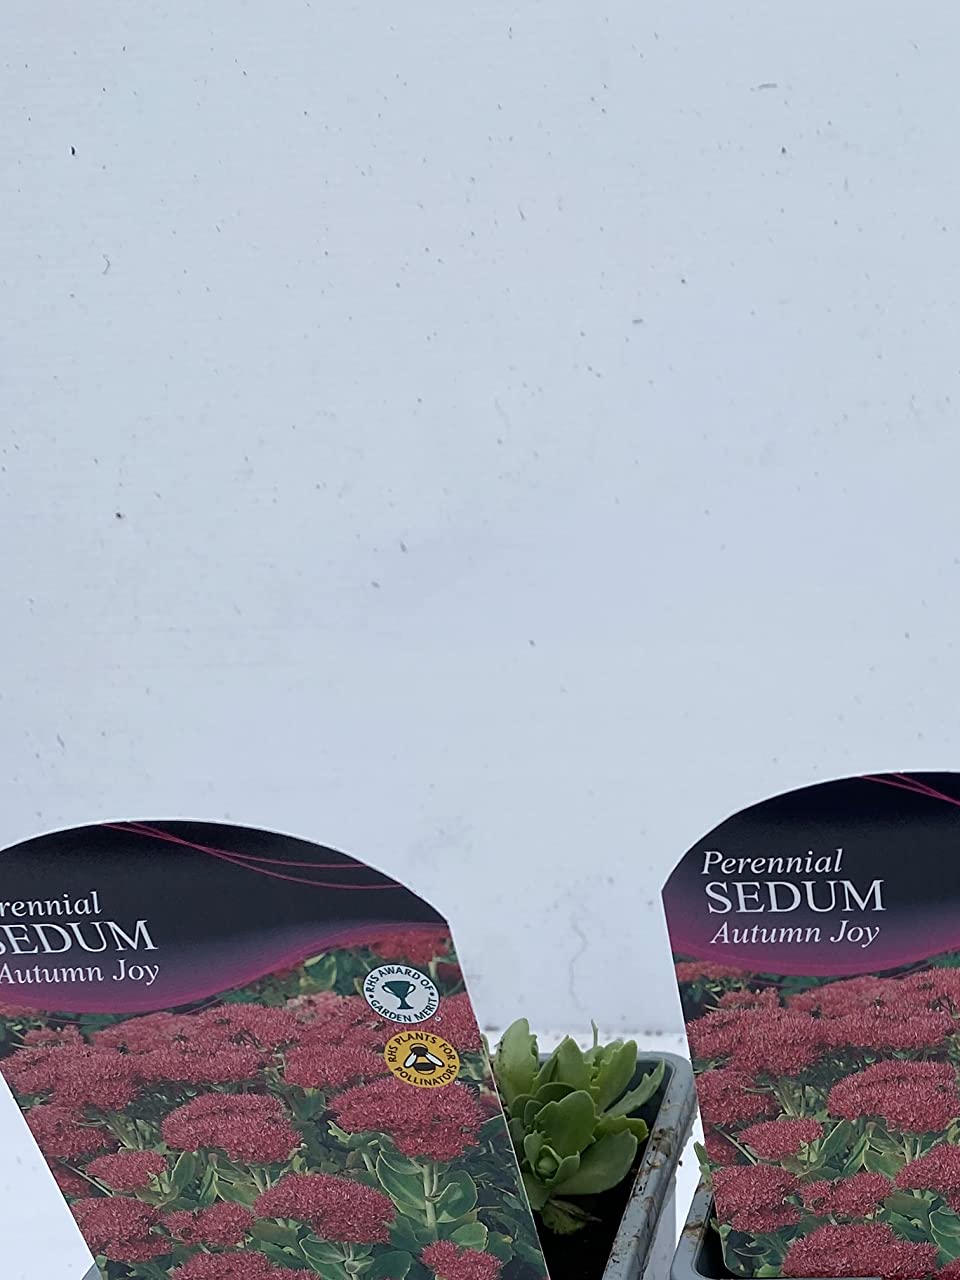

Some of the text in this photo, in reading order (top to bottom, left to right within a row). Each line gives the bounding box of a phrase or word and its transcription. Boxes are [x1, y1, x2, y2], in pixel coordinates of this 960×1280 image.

[701, 848, 843, 875] Perennial
[705, 879, 887, 914] SEDUM
[0, 919, 159, 955] EDUM
[709, 919, 880, 948] Autumn Joy
[0, 959, 159, 986] Autumn Joy
[366, 966, 434, 993] RHS AWARD OF
[371, 997, 437, 1022] GARDEN MERIT
[388, 1032, 456, 1063] RHS PLANTS FOR
[394, 1064, 457, 1086] POLLINATORS
